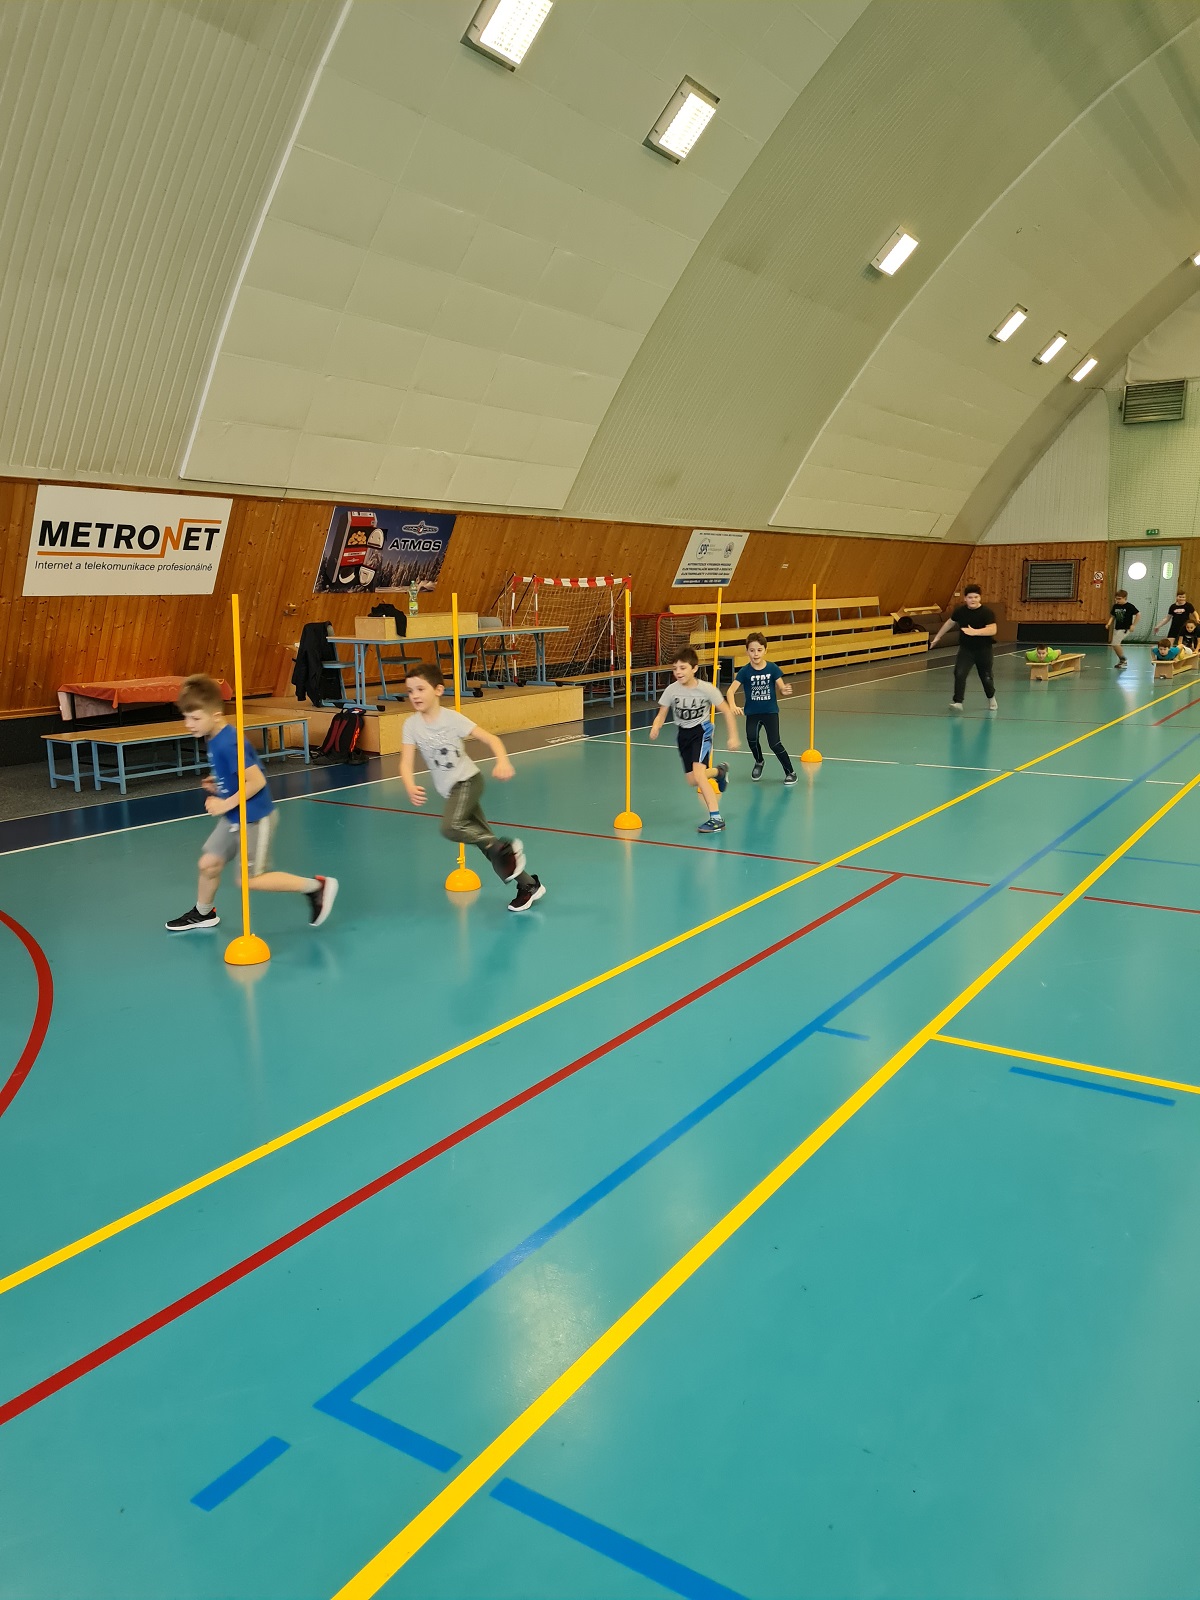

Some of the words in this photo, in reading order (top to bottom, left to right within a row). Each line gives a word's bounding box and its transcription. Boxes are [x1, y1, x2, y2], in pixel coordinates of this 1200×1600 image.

[38, 519, 221, 551] METRONET
[388, 538, 442, 552] ATMOS
[34, 560, 73, 570] Internet
[75, 562, 82, 570] a
[84, 560, 155, 571] telekomunikace
[156, 561, 213, 572] profesionálně
